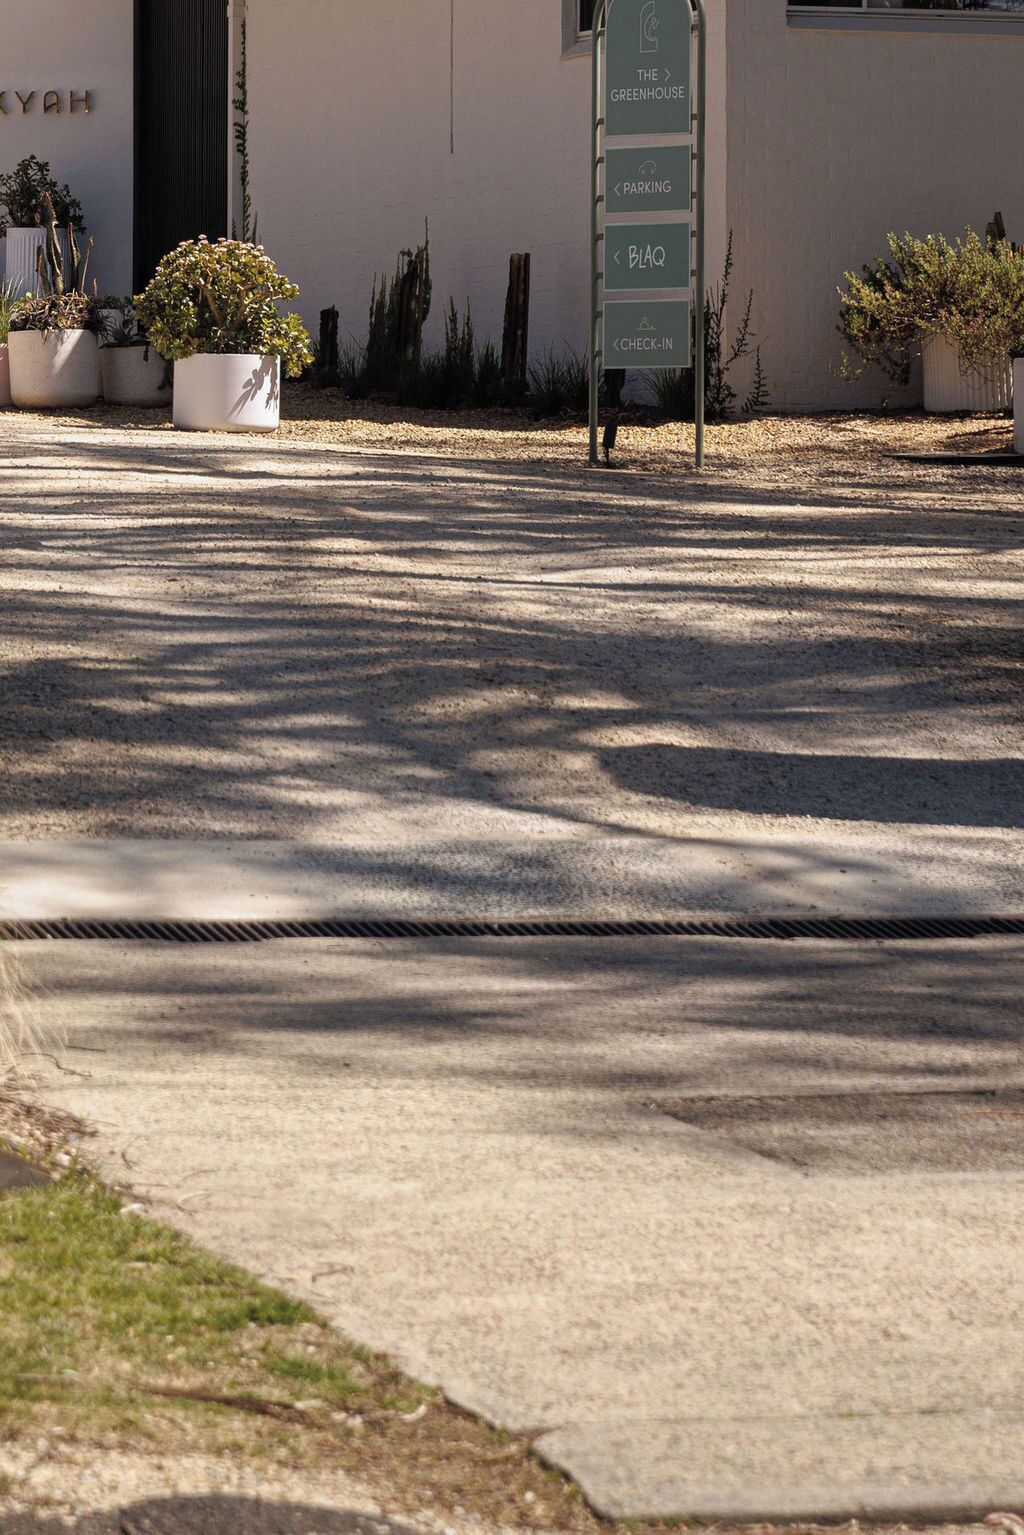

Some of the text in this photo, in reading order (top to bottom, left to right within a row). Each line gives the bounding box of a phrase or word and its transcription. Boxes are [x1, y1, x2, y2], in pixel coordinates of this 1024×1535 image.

[637, 68, 658, 82] THE
[610, 85, 685, 102] GREENHOUSE
[623, 180, 672, 195] PARKING
[628, 244, 666, 269] BLAQ
[620, 337, 673, 351] CHECK-IN
